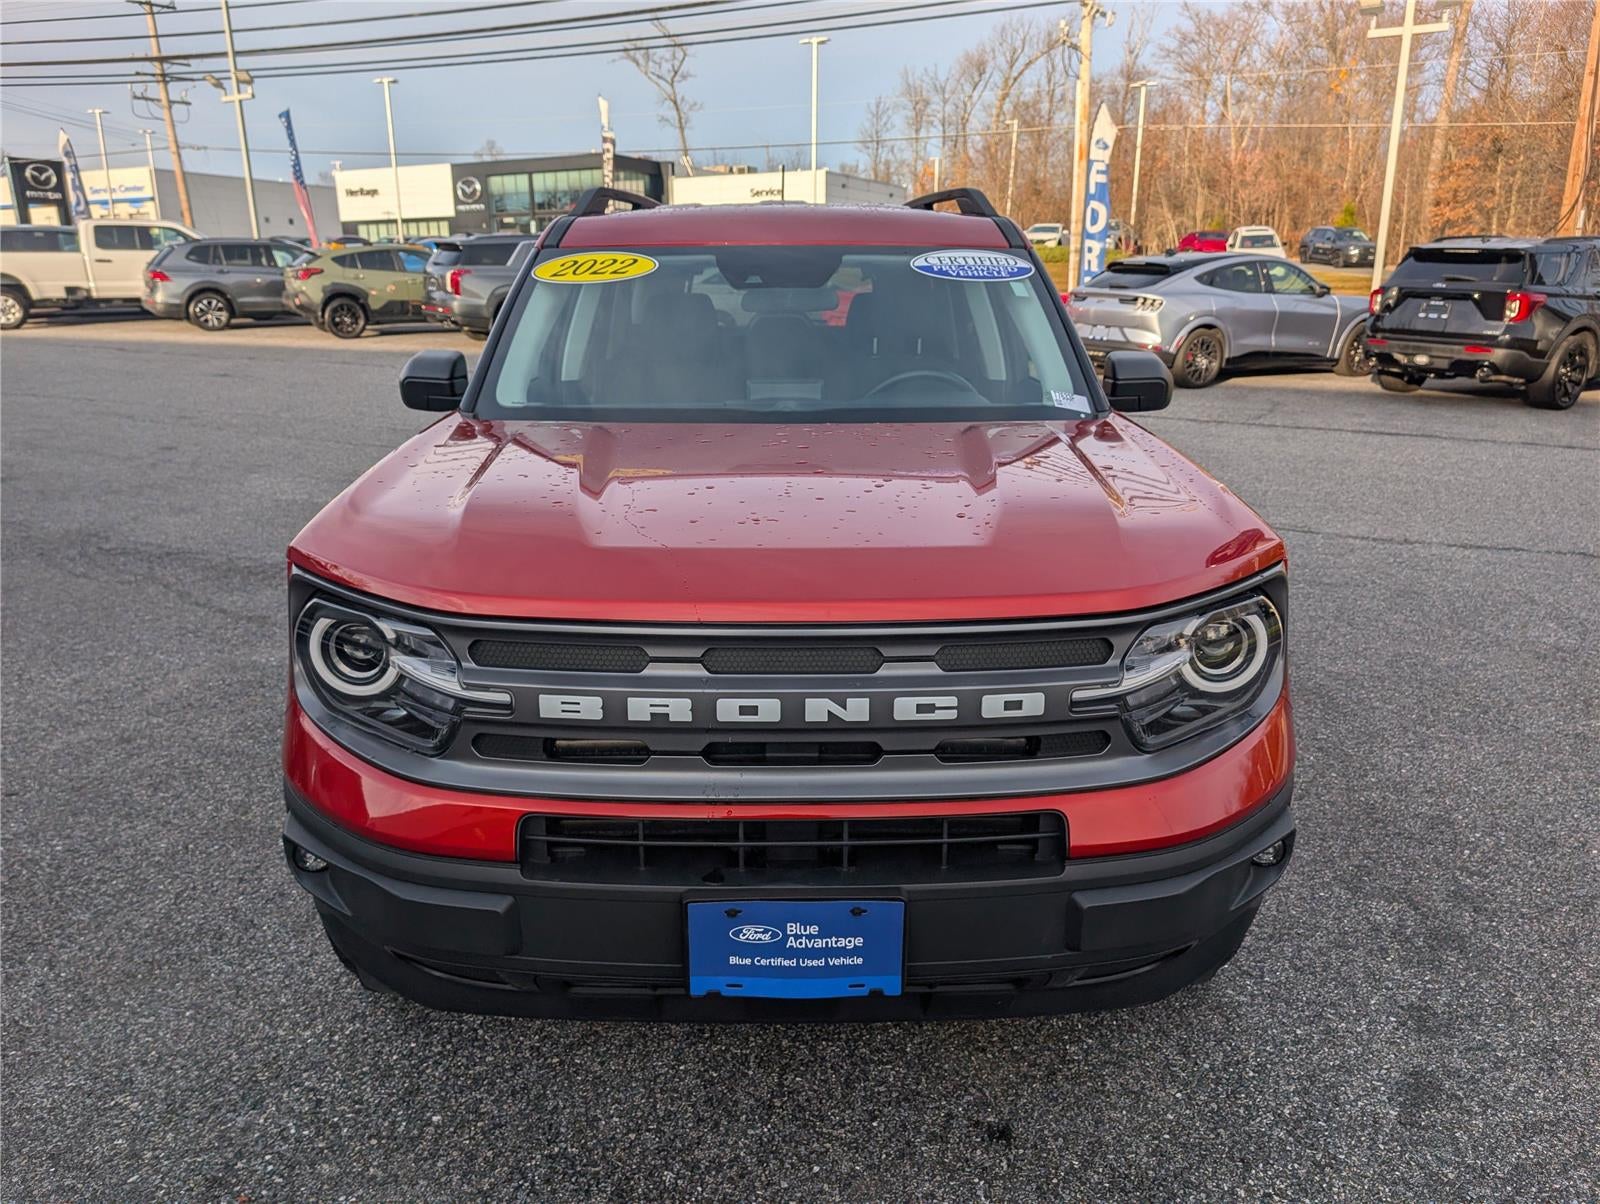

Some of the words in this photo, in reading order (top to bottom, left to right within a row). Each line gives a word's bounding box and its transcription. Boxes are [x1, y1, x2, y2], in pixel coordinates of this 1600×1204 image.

[345, 187, 379, 198] Heritage
[750, 187, 783, 198] Service
[925, 255, 1018, 266] CERTIFIED
[549, 258, 639, 278] 2022
[933, 264, 1018, 273] PRE-OWNED
[538, 692, 1046, 722] BRONCO
[739, 927, 772, 941] Ford
[786, 922, 819, 935] Blue
[786, 936, 864, 949] Advantage
[729, 956, 751, 965] Blue
[754, 956, 797, 966] Certified
[800, 957, 825, 966] Used
[828, 956, 864, 966] Vehicle
